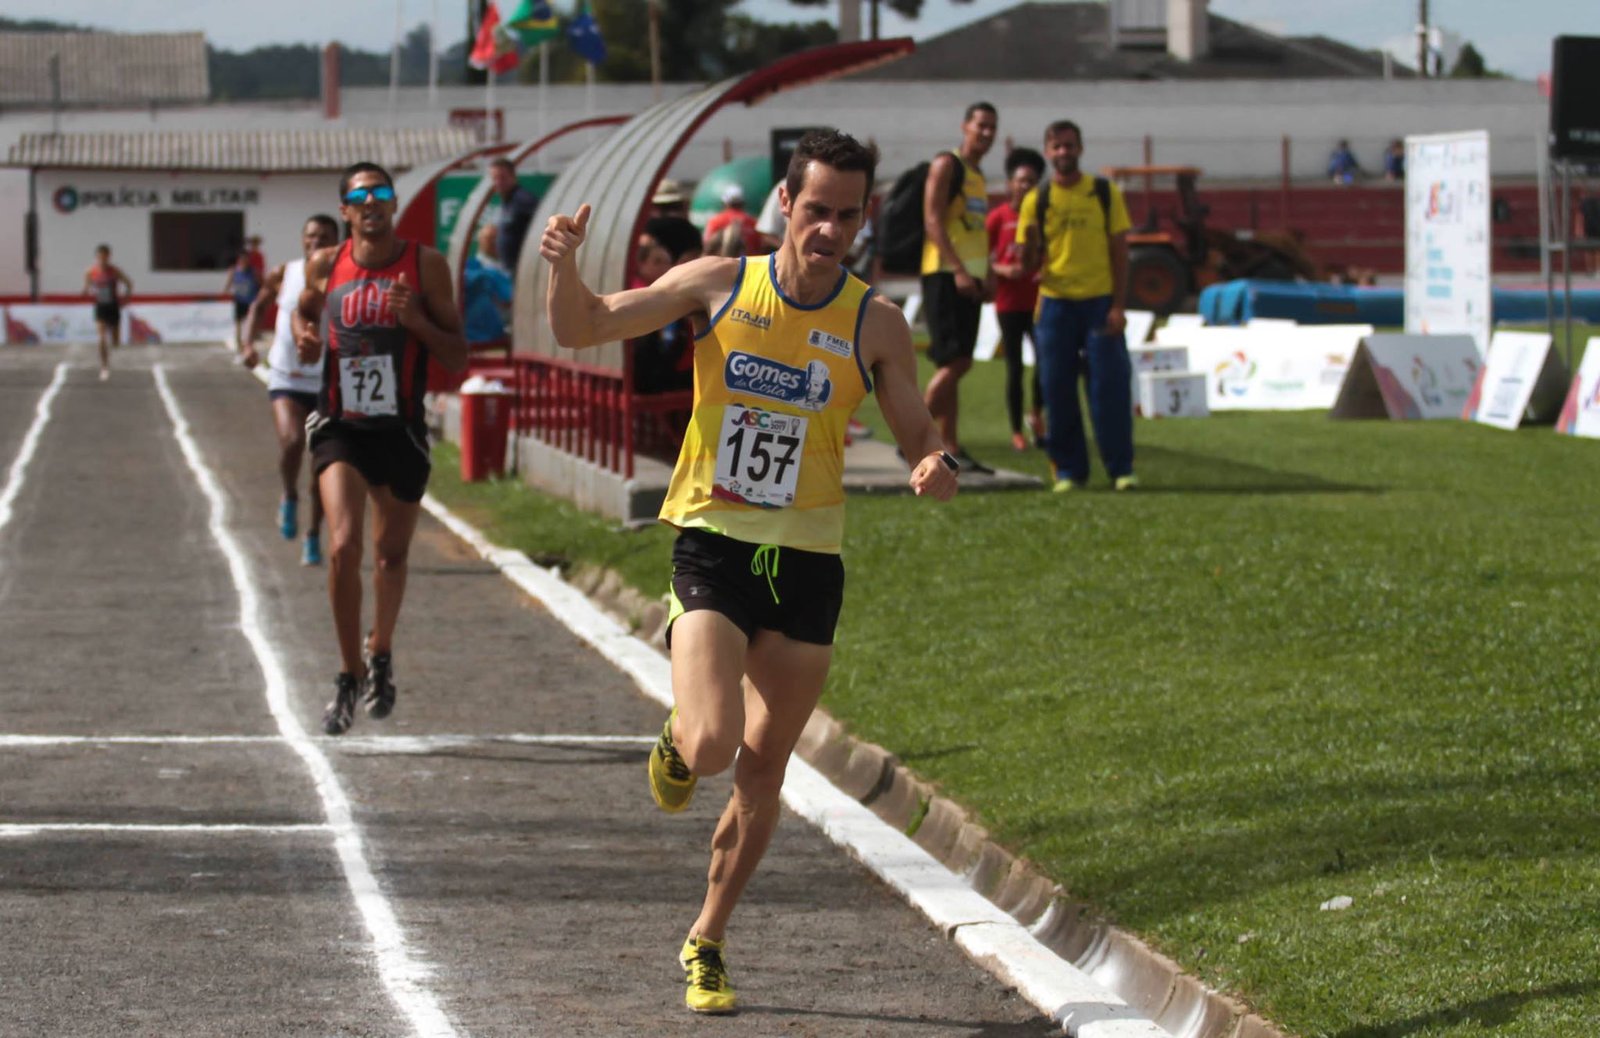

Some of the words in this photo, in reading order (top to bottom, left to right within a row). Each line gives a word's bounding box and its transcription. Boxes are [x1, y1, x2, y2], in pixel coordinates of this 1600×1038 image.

[170, 185, 259, 206] MILITAR
[826, 335, 850, 350] FMEL
[351, 369, 385, 403] 72
[729, 354, 801, 390] Gomes
[748, 376, 786, 398] Costa
[726, 427, 800, 485] 157
